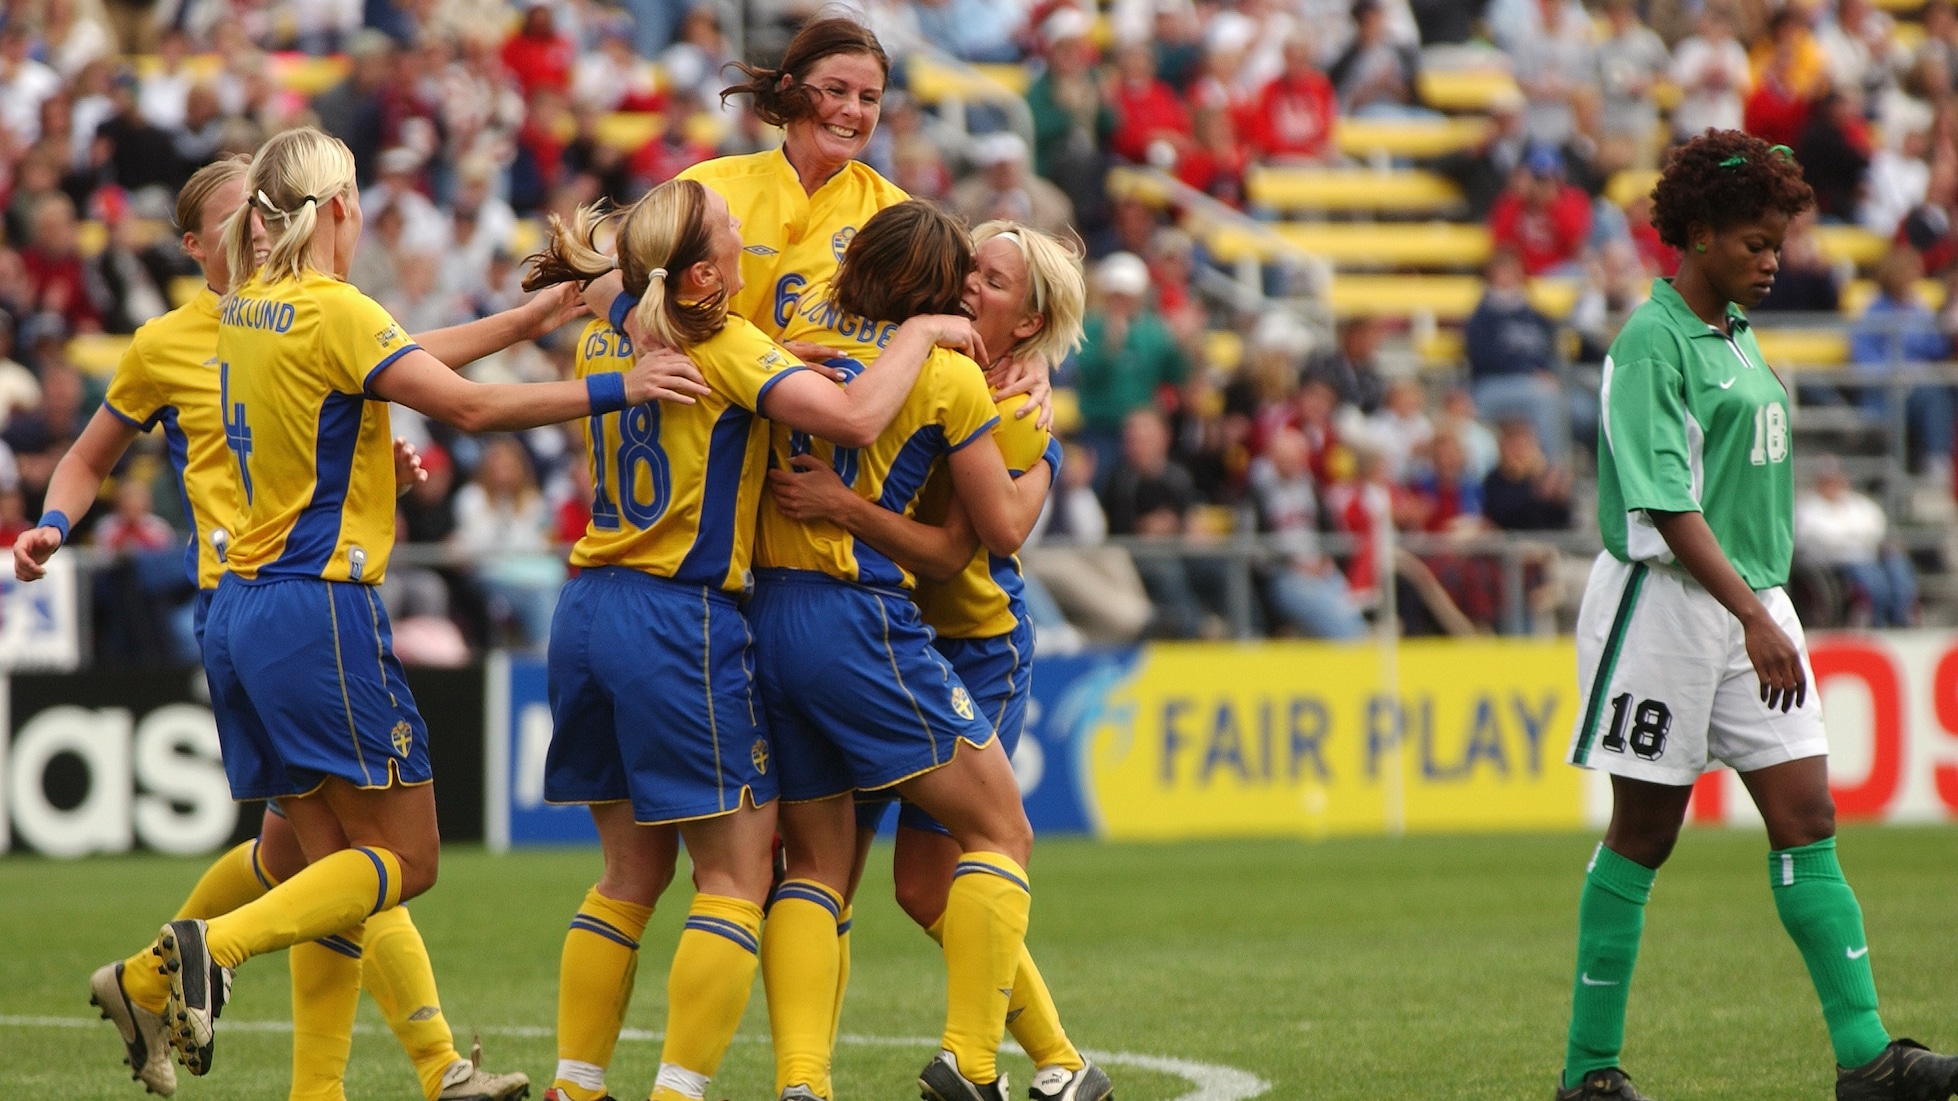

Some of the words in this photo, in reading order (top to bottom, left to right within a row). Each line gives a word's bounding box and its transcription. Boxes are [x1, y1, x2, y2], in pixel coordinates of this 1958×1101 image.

[222, 296, 294, 333] ARKLUND
[774, 272, 806, 328] 6
[220, 361, 253, 506] 4
[589, 399, 672, 532] 18
[1750, 401, 1788, 466] 18
[0, 670, 240, 857] as
[1158, 695, 1330, 785] FAIR
[1366, 692, 1561, 781] PLAY
[1602, 691, 1673, 762] 18
